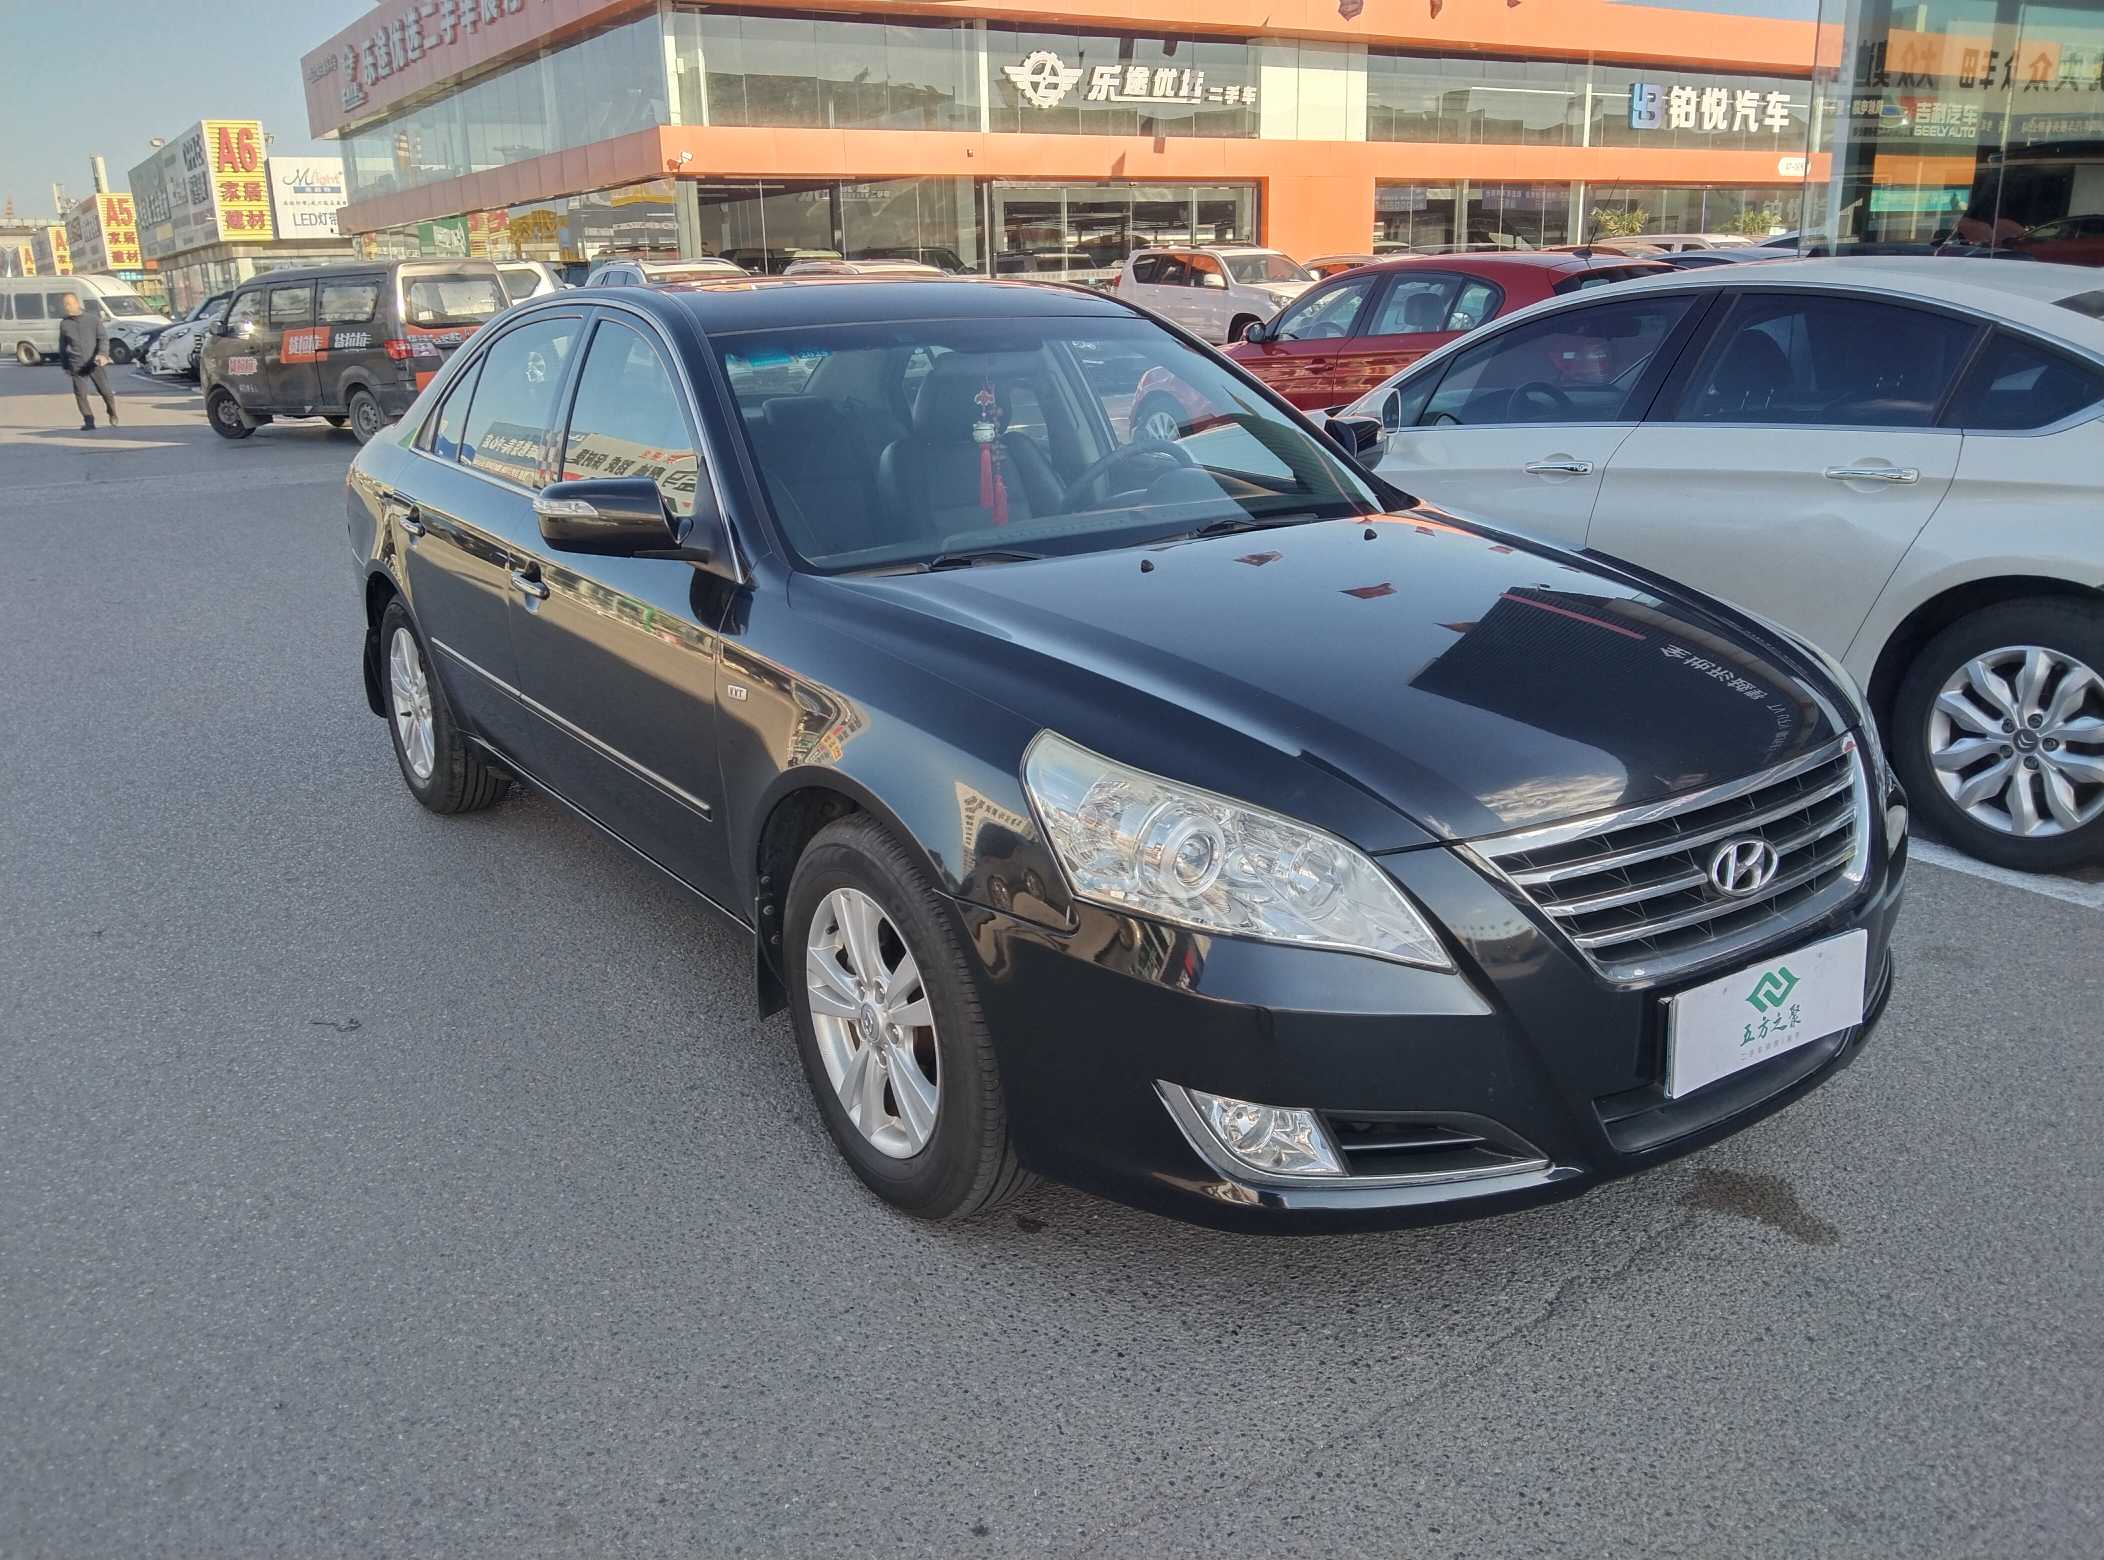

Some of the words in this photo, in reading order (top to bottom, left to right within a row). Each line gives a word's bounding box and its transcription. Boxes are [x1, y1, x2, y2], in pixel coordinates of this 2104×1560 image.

[1207, 86, 1256, 105] 二手车
[1669, 86, 1791, 134] 铂悦汽车
[1915, 102, 1979, 125] 吉利汽车
[217, 127, 257, 172] A6
[221, 181, 261, 202] 家居
[106, 197, 133, 226] A5
[224, 210, 265, 230] 建材
[1740, 1003, 1801, 1048] 五方之聚
